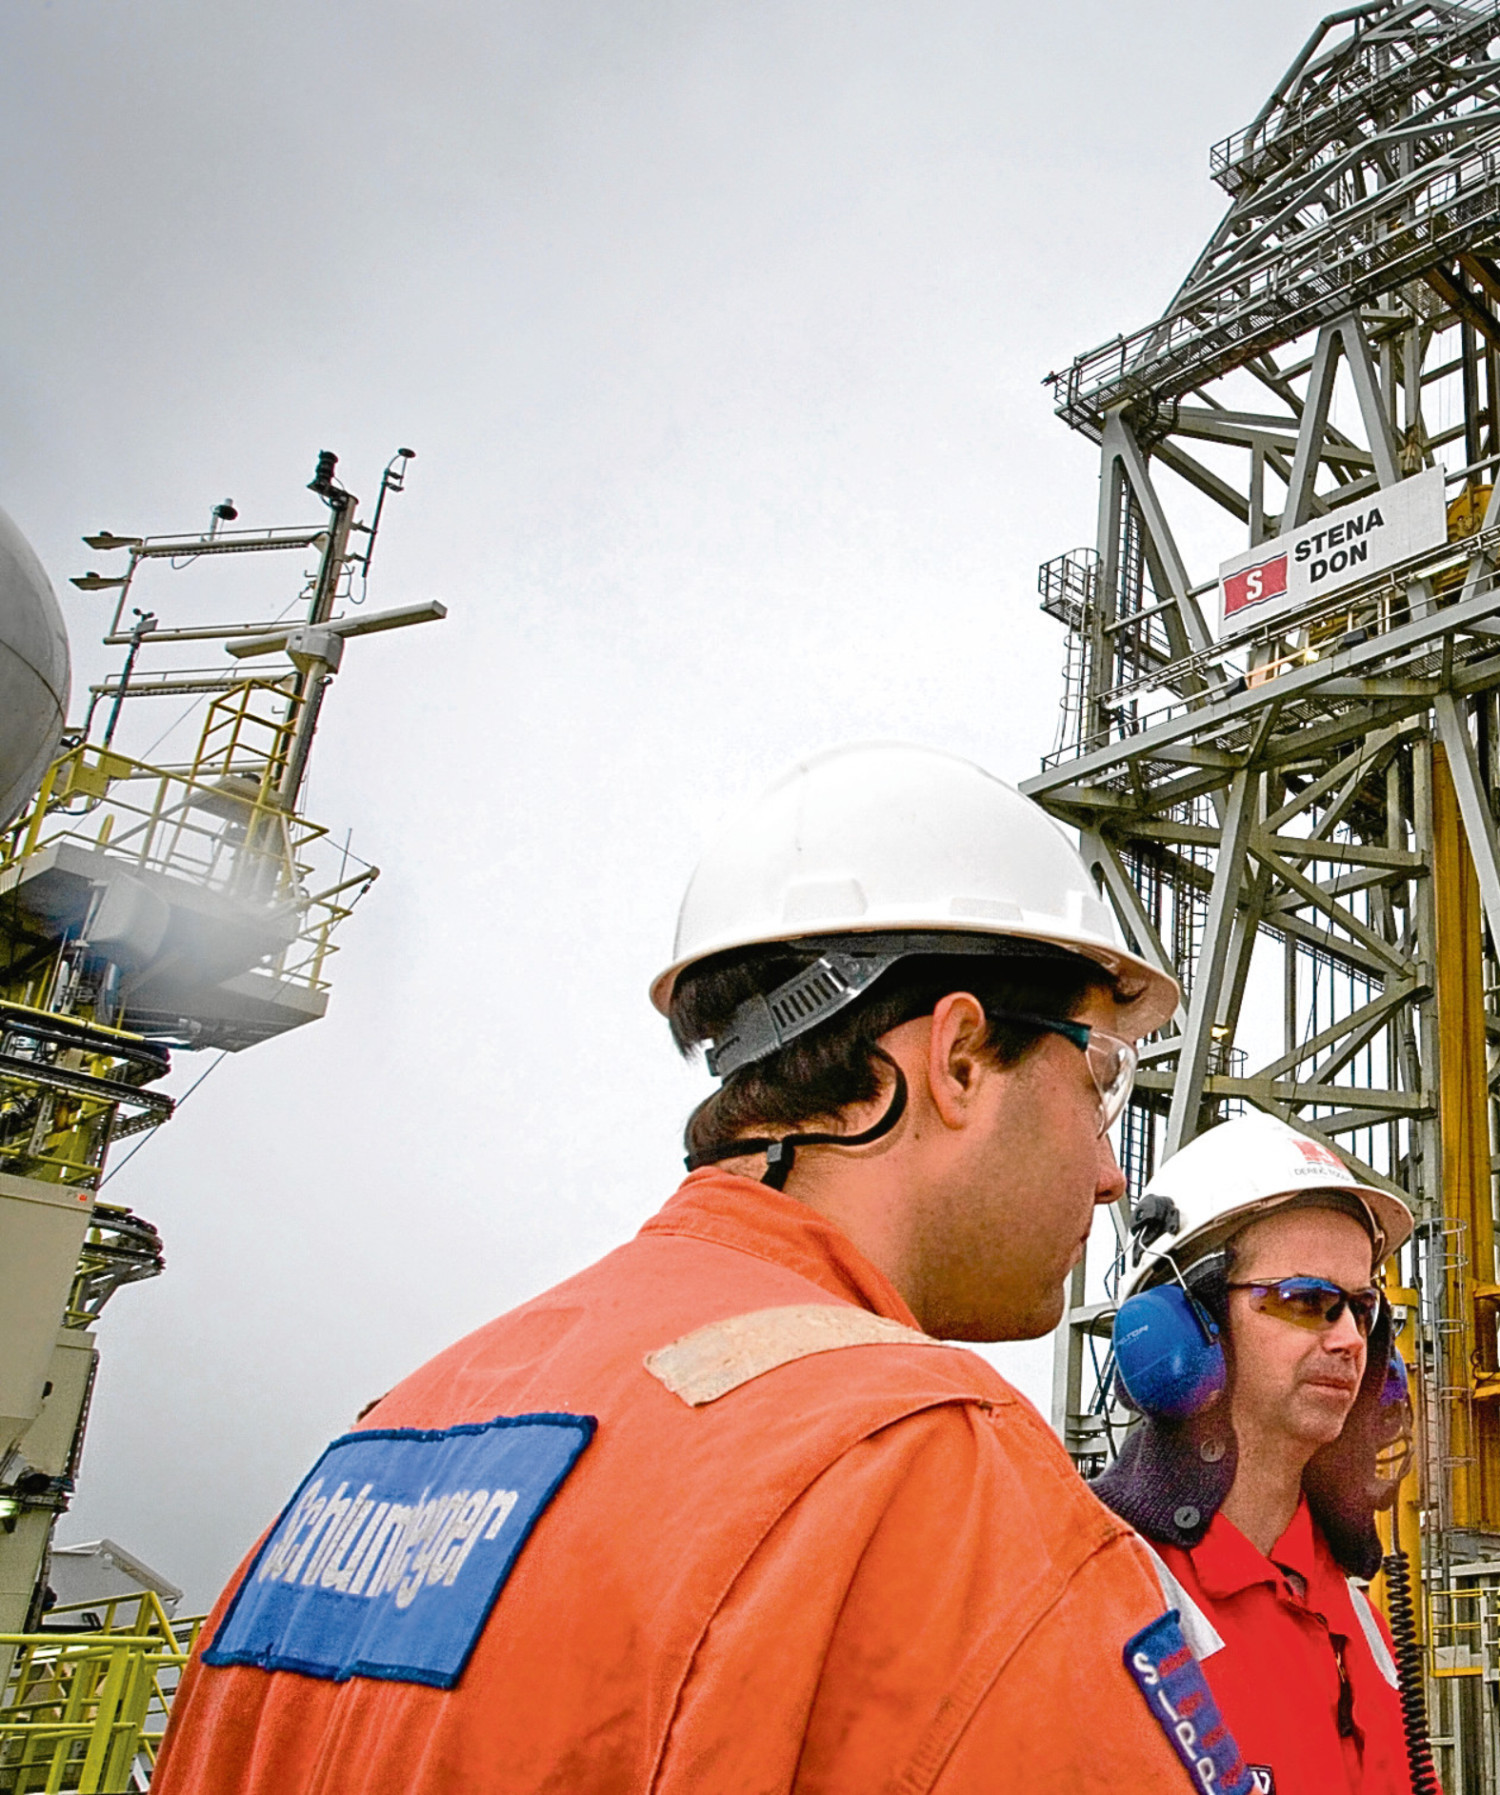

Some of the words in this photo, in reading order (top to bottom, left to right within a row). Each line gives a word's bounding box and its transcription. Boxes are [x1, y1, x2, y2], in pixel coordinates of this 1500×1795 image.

[1294, 507, 1385, 563] STENA
[1310, 539, 1368, 584] DON
[1245, 569, 1263, 601] S
